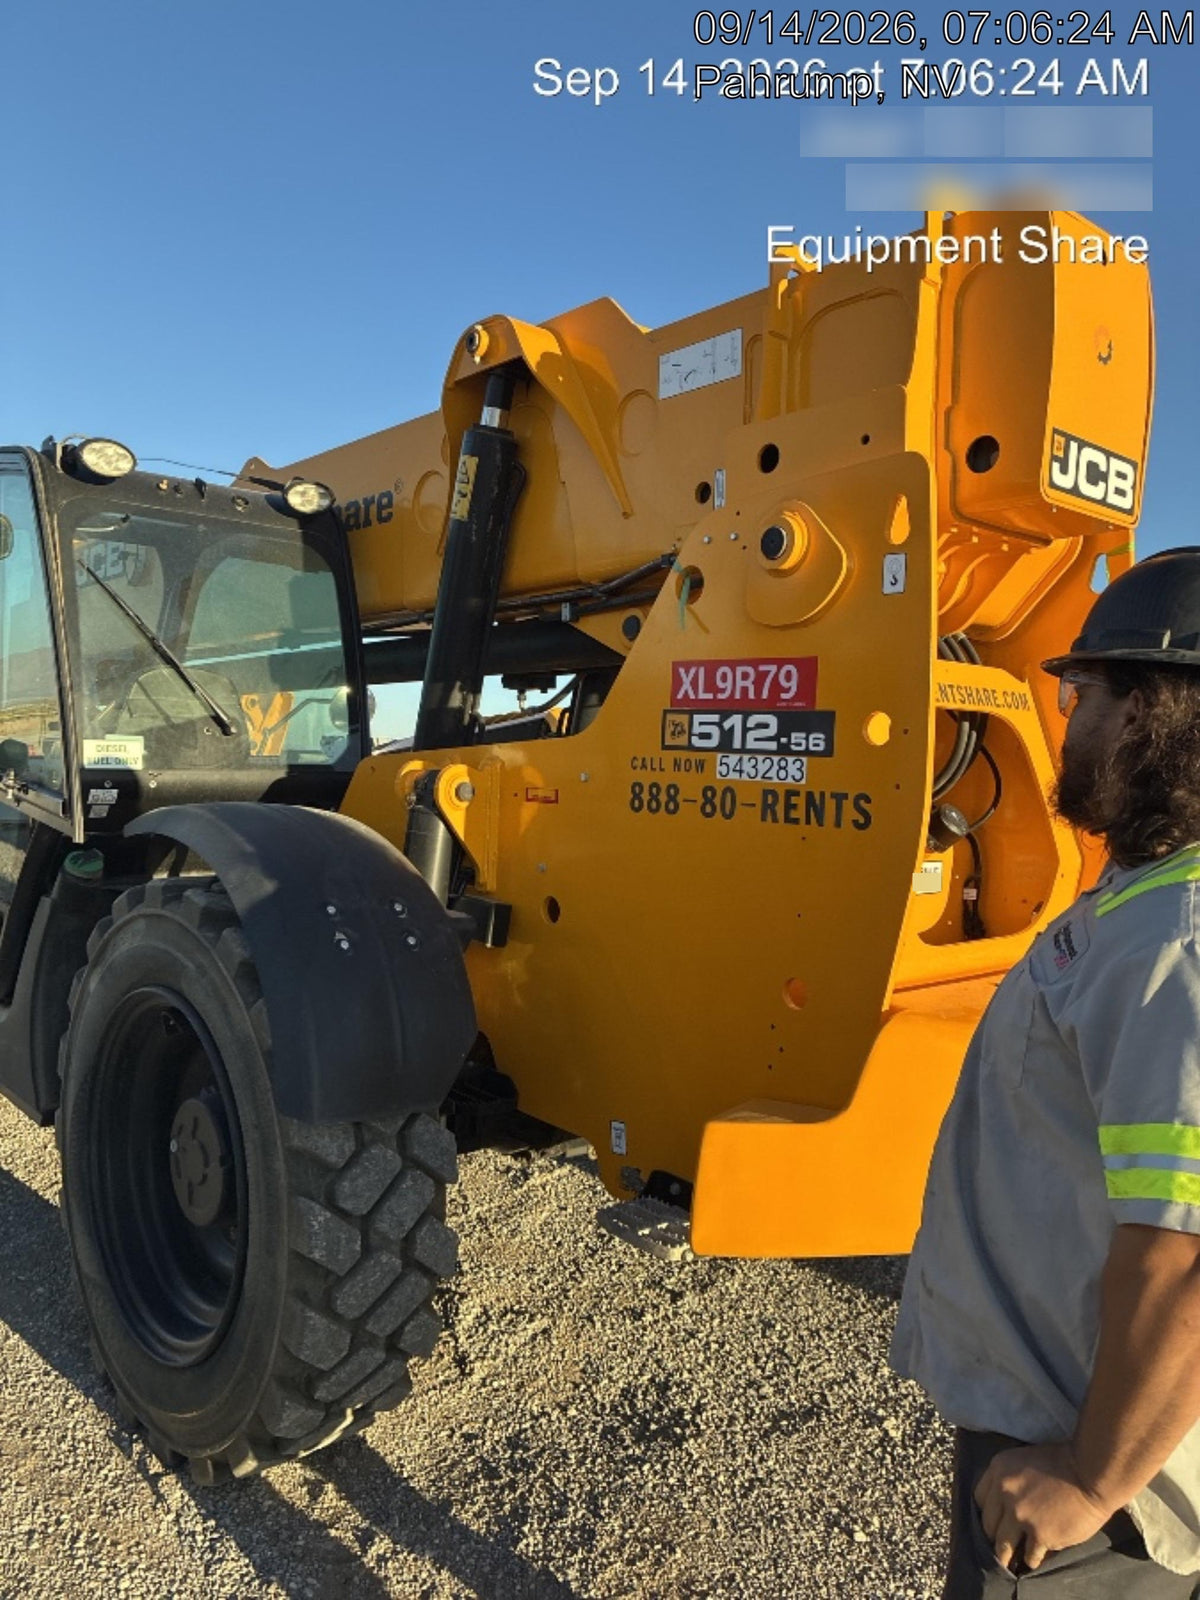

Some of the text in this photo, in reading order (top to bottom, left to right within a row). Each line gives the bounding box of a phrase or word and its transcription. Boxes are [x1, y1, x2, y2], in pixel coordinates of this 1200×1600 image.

[1051, 440, 1135, 510] JCB
[676, 664, 799, 701] XL9R79
[935, 682, 1031, 712] NTSHARE.COM
[630, 756, 706, 774] CALL NOW
[718, 755, 806, 783] 543283
[629, 781, 873, 831] 888-80-RENTS
